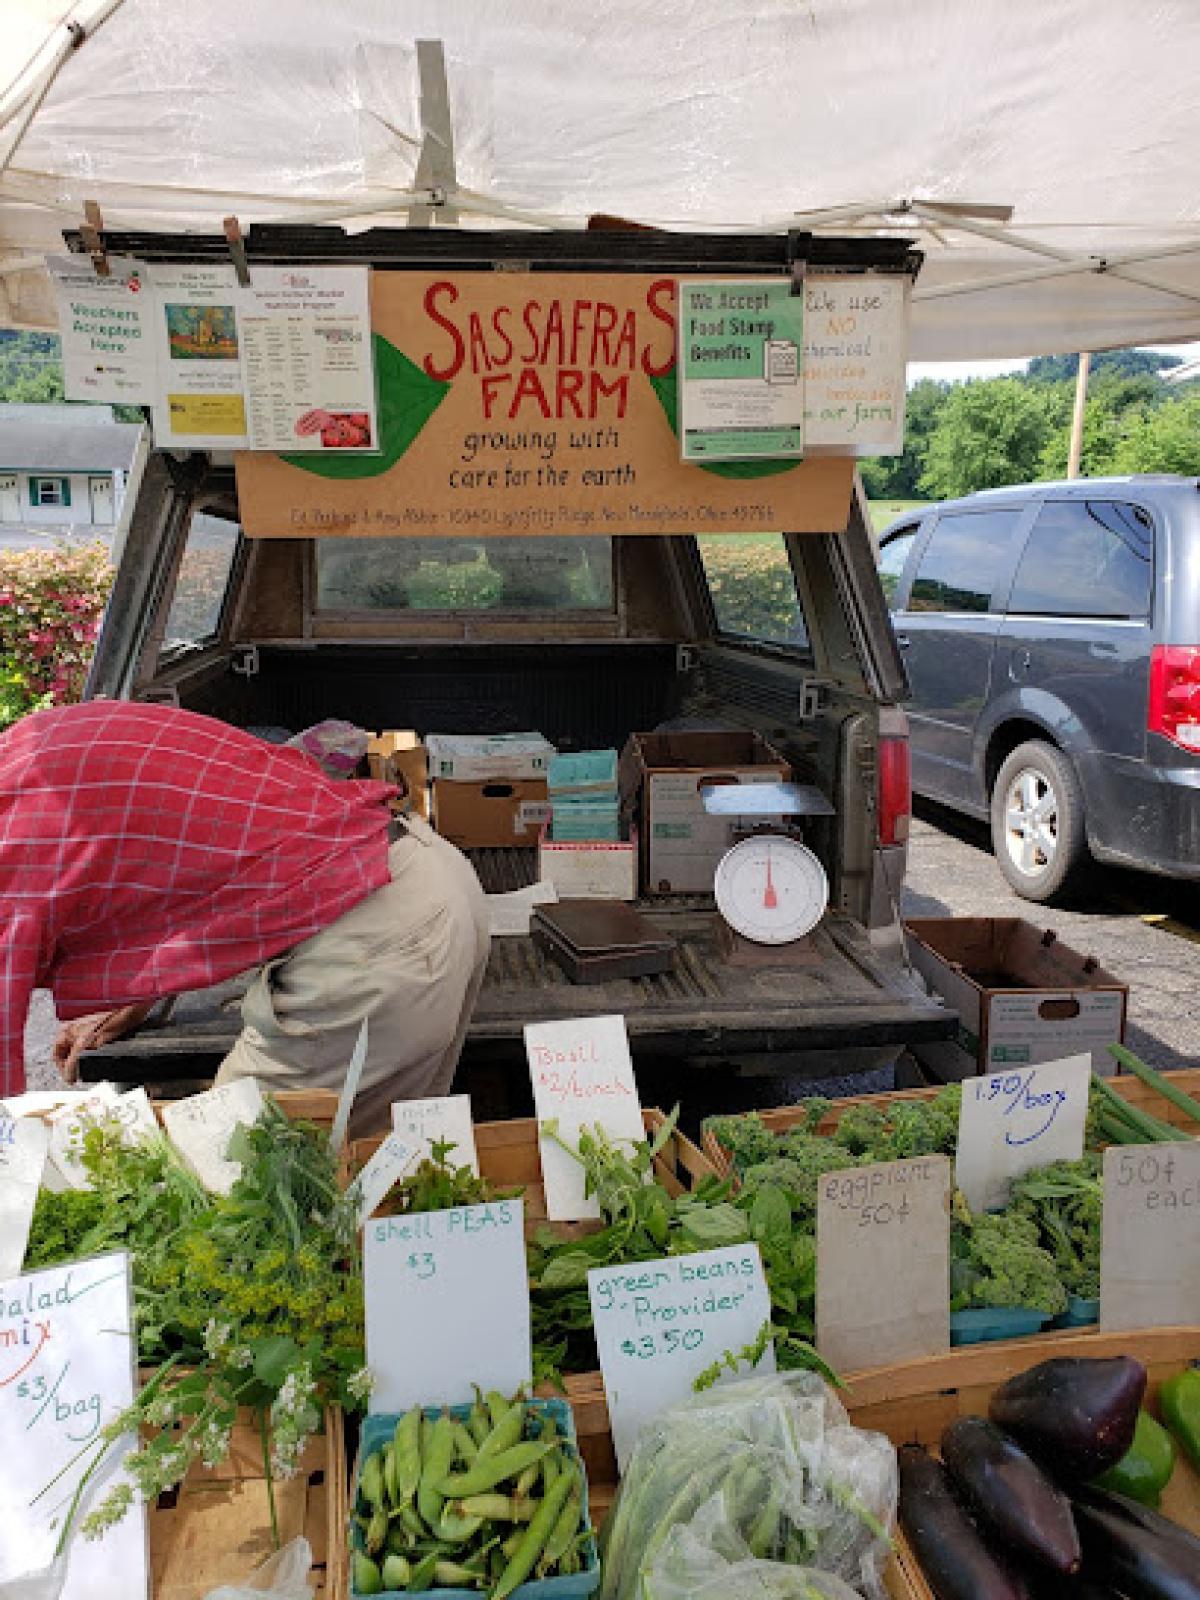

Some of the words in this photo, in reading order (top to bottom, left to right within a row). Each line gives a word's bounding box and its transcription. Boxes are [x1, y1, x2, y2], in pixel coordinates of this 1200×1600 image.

[70, 302, 139, 321] Vouchers
[690, 293, 713, 310] We
[718, 292, 769, 315] Accept
[849, 293, 882, 313] use
[73, 320, 142, 339] Accepted
[424, 280, 678, 382] SASSAFRAS
[690, 318, 724, 336] Food
[729, 316, 776, 339] Stamp
[827, 317, 858, 336] NO
[90, 338, 127, 354] Here
[690, 343, 751, 363] Benefits
[481, 367, 630, 420] FARM
[847, 401, 893, 433] farm
[461, 429, 557, 463] growing
[570, 426, 620, 449] with
[450, 466, 499, 489] care
[505, 459, 533, 489] for
[537, 463, 569, 488] the
[581, 463, 636, 489] earth
[826, 1162, 931, 1210] eggplant
[374, 1214, 434, 1243] shell
[447, 1202, 514, 1234] PEAS
[406, 1252, 437, 1280] $3
[597, 1272, 671, 1310] green
[679, 1257, 755, 1284] beans
[620, 1328, 705, 1361] $3.50
